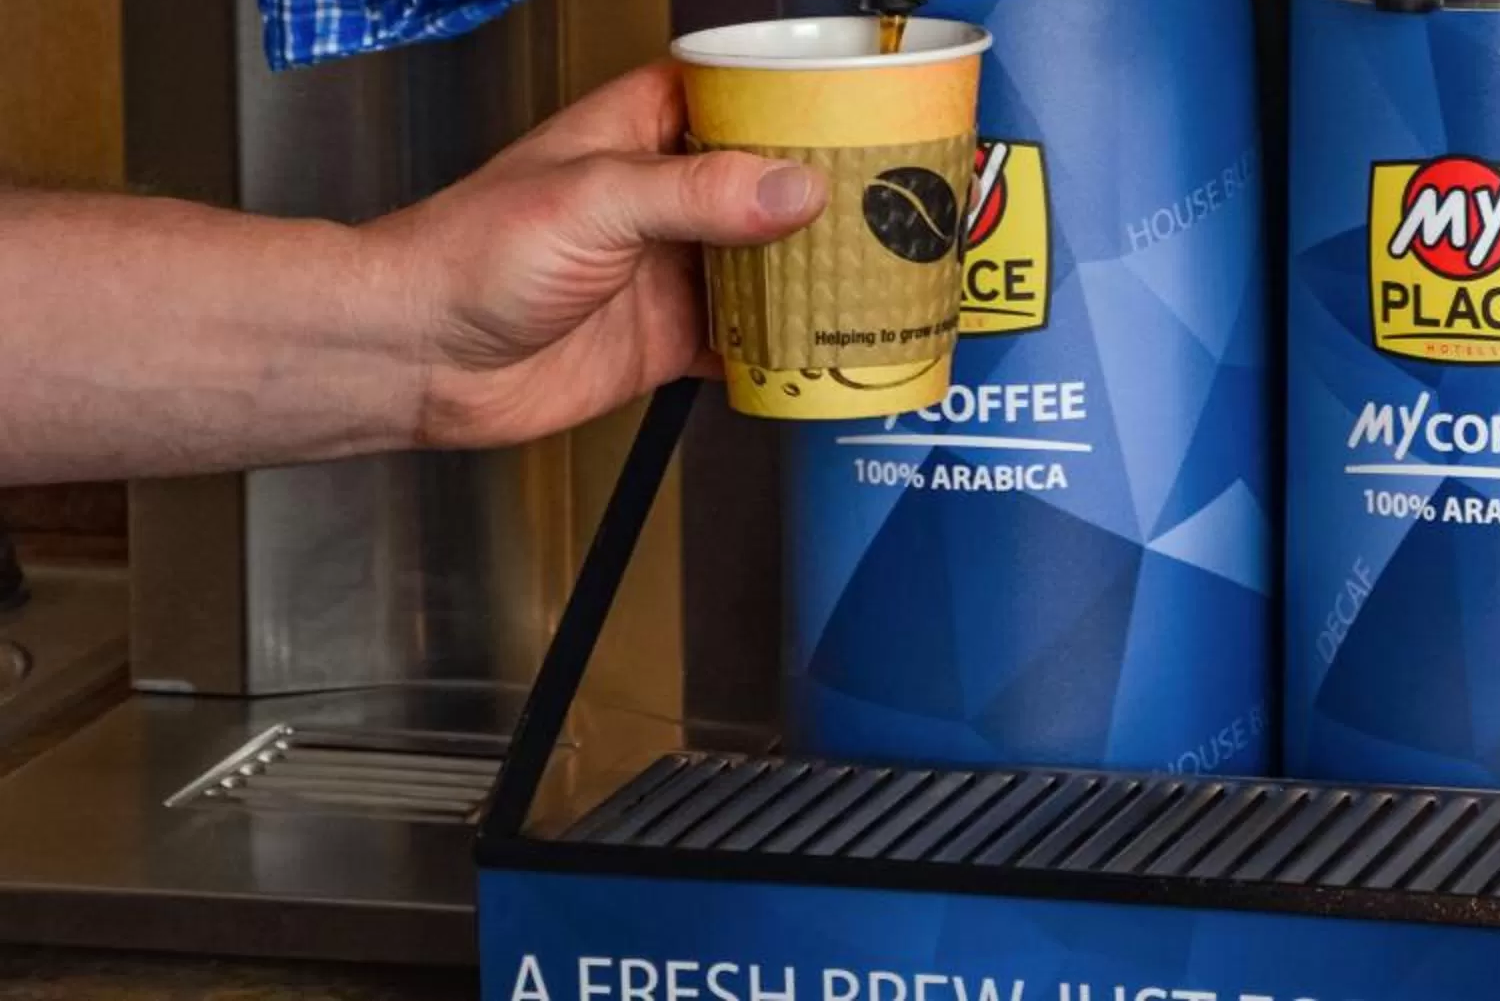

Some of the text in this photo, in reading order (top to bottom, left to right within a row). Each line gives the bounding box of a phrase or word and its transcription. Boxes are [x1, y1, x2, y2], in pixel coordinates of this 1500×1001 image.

[1126, 179, 1222, 252] HOUSE
[815, 330, 876, 347] Helping
[880, 329, 896, 343] to
[900, 325, 932, 344] grow
[854, 458, 1069, 491] 100% ARABICA
[1363, 488, 1435, 522] 100%
[1315, 555, 1374, 665] DECAF
[1155, 714, 1249, 777] OUSE
